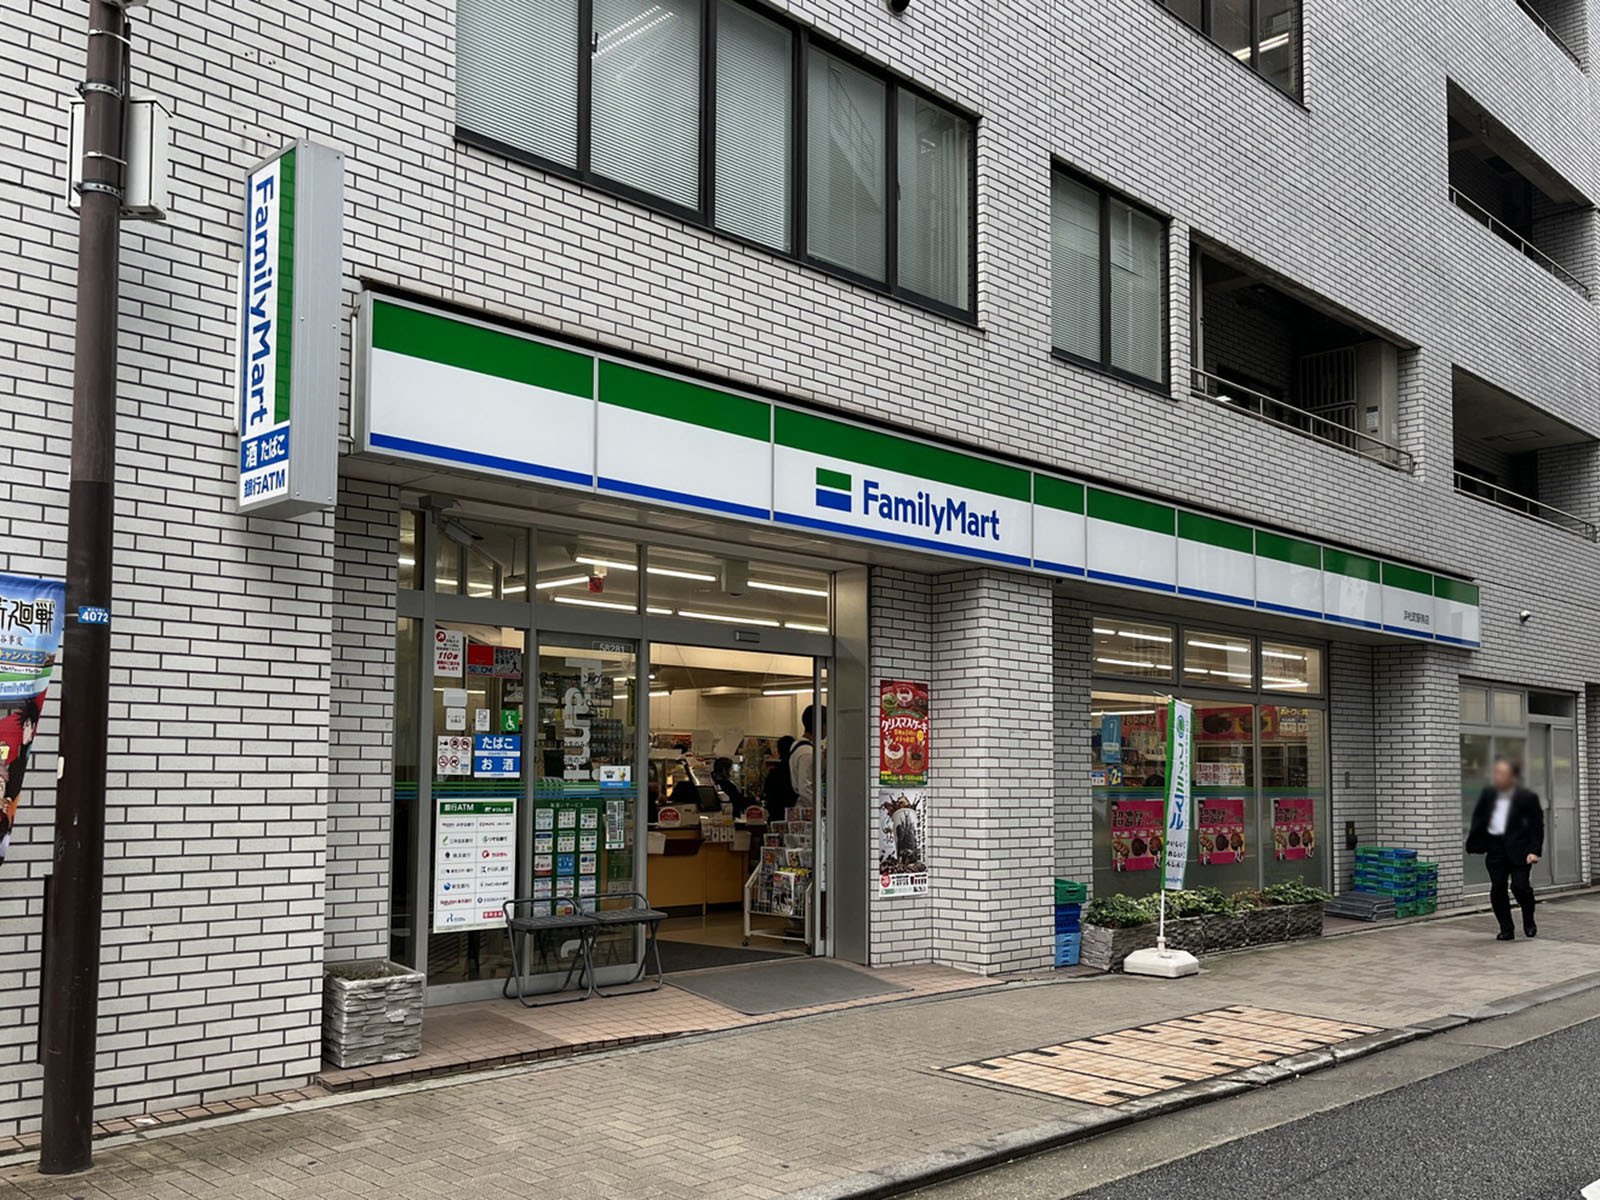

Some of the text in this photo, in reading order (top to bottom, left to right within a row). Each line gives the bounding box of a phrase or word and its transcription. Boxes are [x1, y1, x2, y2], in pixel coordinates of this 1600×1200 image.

[250, 176, 275, 427] FamilyMart
[245, 434, 286, 469] 酒 たばこ
[244, 468, 286, 498] 銀行ATM
[863, 479, 1000, 541] FamilyMart
[81, 611, 109, 623] 4072
[882, 717, 928, 733] クリスマスケーキ
[482, 736, 514, 749] たばこ
[444, 803, 475, 812] 銀行ATM
